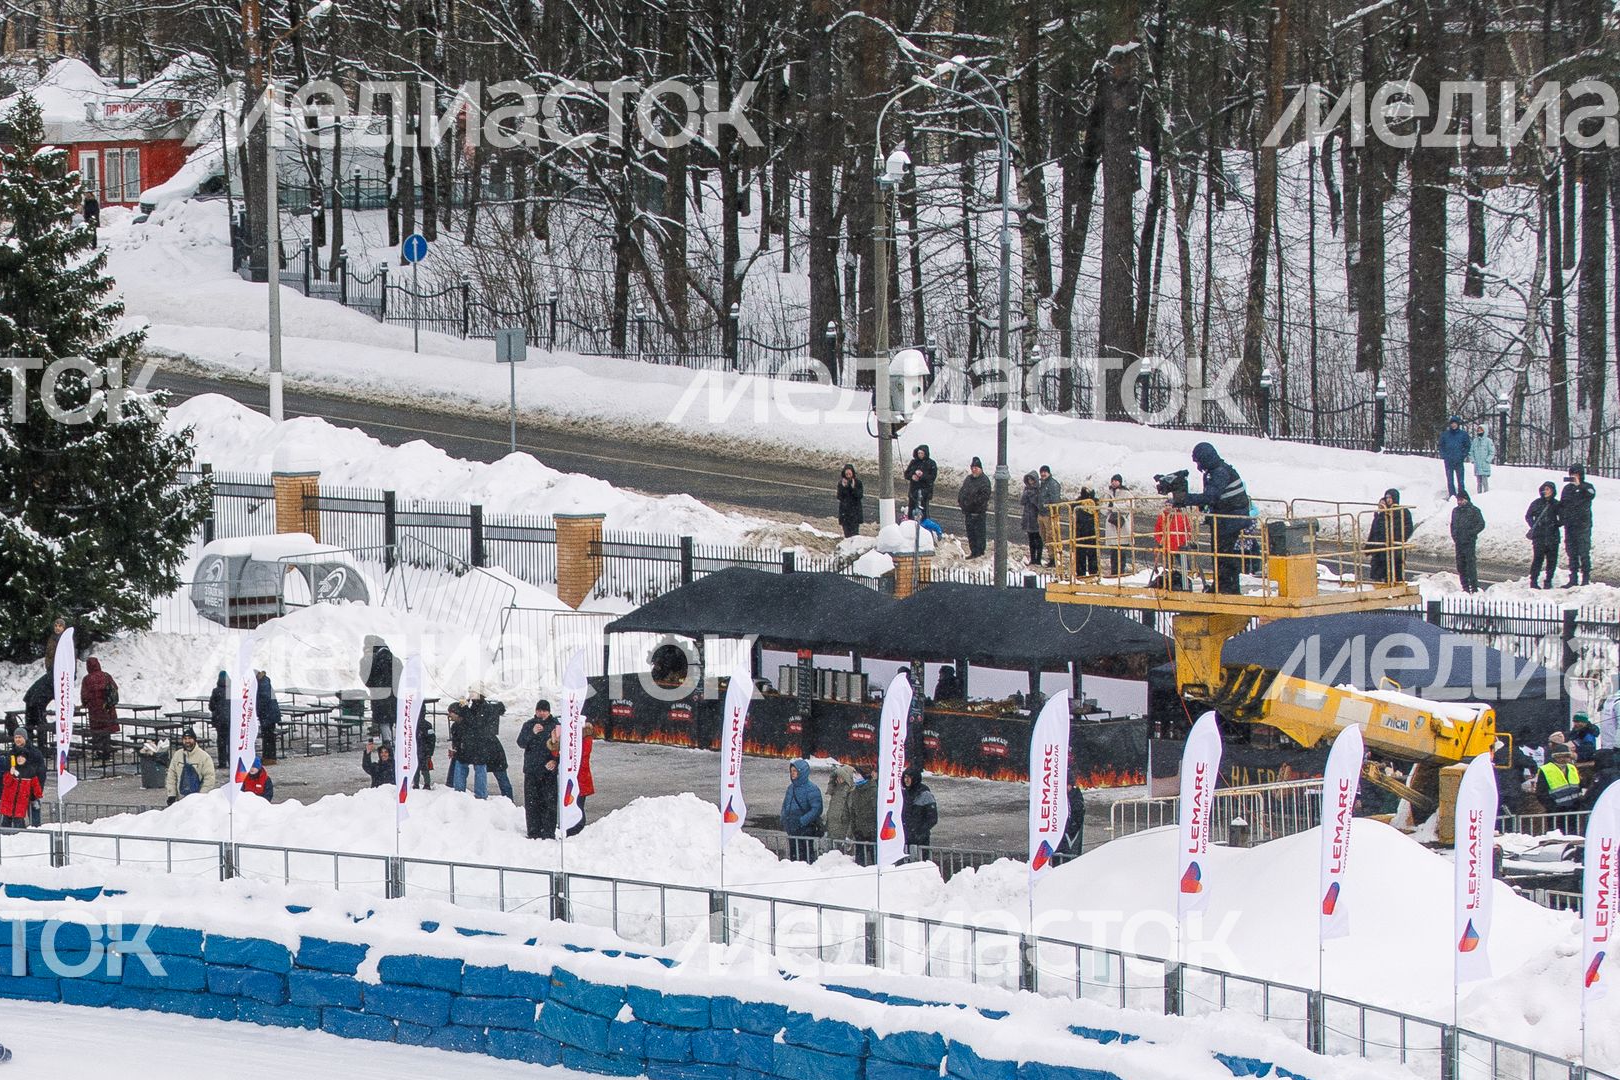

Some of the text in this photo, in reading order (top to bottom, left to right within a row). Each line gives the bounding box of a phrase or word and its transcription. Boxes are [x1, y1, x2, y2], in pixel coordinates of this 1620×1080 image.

[887, 718, 900, 804] LEMARC
[1039, 743, 1053, 832] LEMARC
[1051, 780, 1059, 832] МОТОРНЫЕ
[1189, 762, 1205, 854] LEMARC
[1331, 778, 1349, 874] LEMARC
[1466, 809, 1478, 910] LEMARC
[1593, 837, 1612, 942] LEMARC
